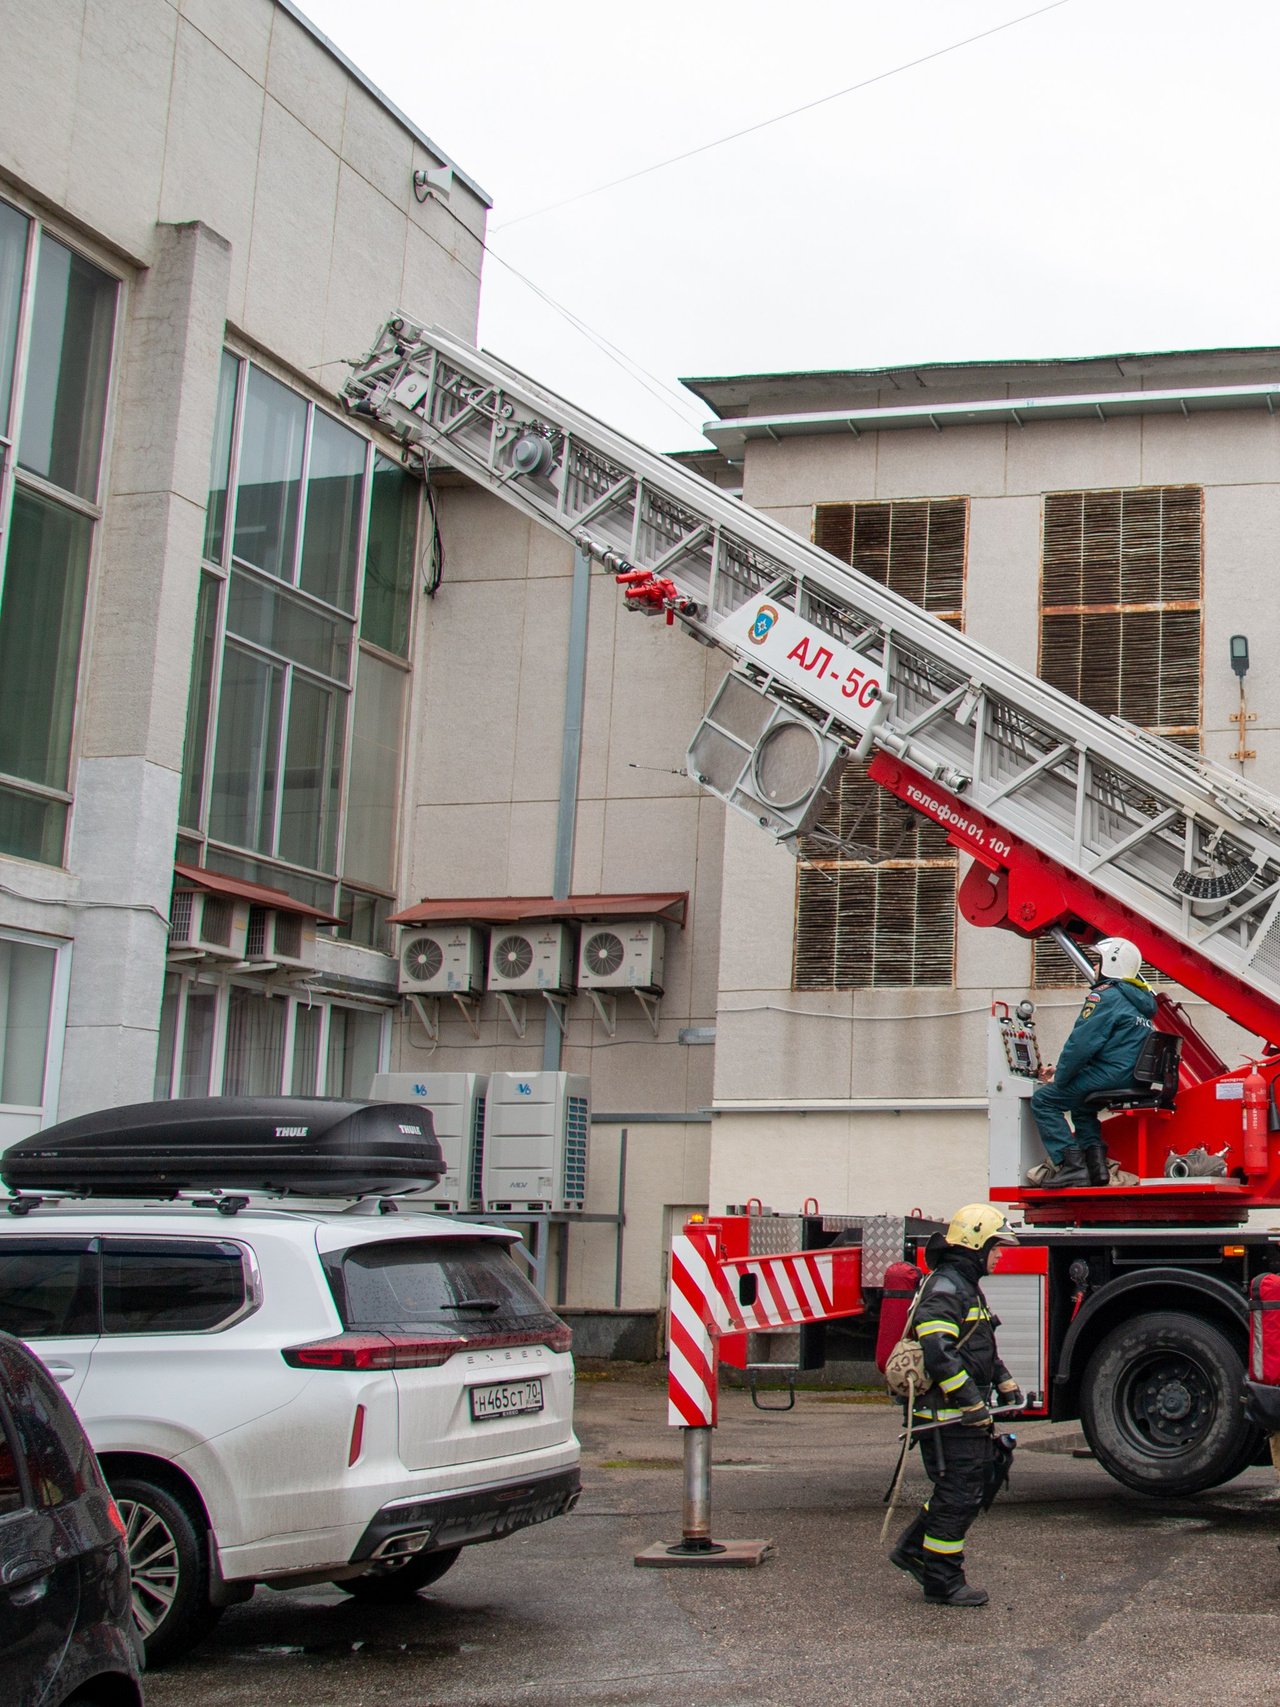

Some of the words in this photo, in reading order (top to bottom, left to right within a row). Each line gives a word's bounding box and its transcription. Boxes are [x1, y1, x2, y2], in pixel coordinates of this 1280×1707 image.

[787, 637, 879, 708] АЛ-50
[907, 785, 969, 831] телефон
[968, 825, 984, 845] 01,
[989, 838, 1011, 858] 101
[275, 1127, 308, 1137] THULE
[399, 1125, 421, 1135] THULE
[467, 1349, 542, 1364] EXEED
[479, 1388, 523, 1411] Н465СТ
[526, 1383, 538, 1399] 70
